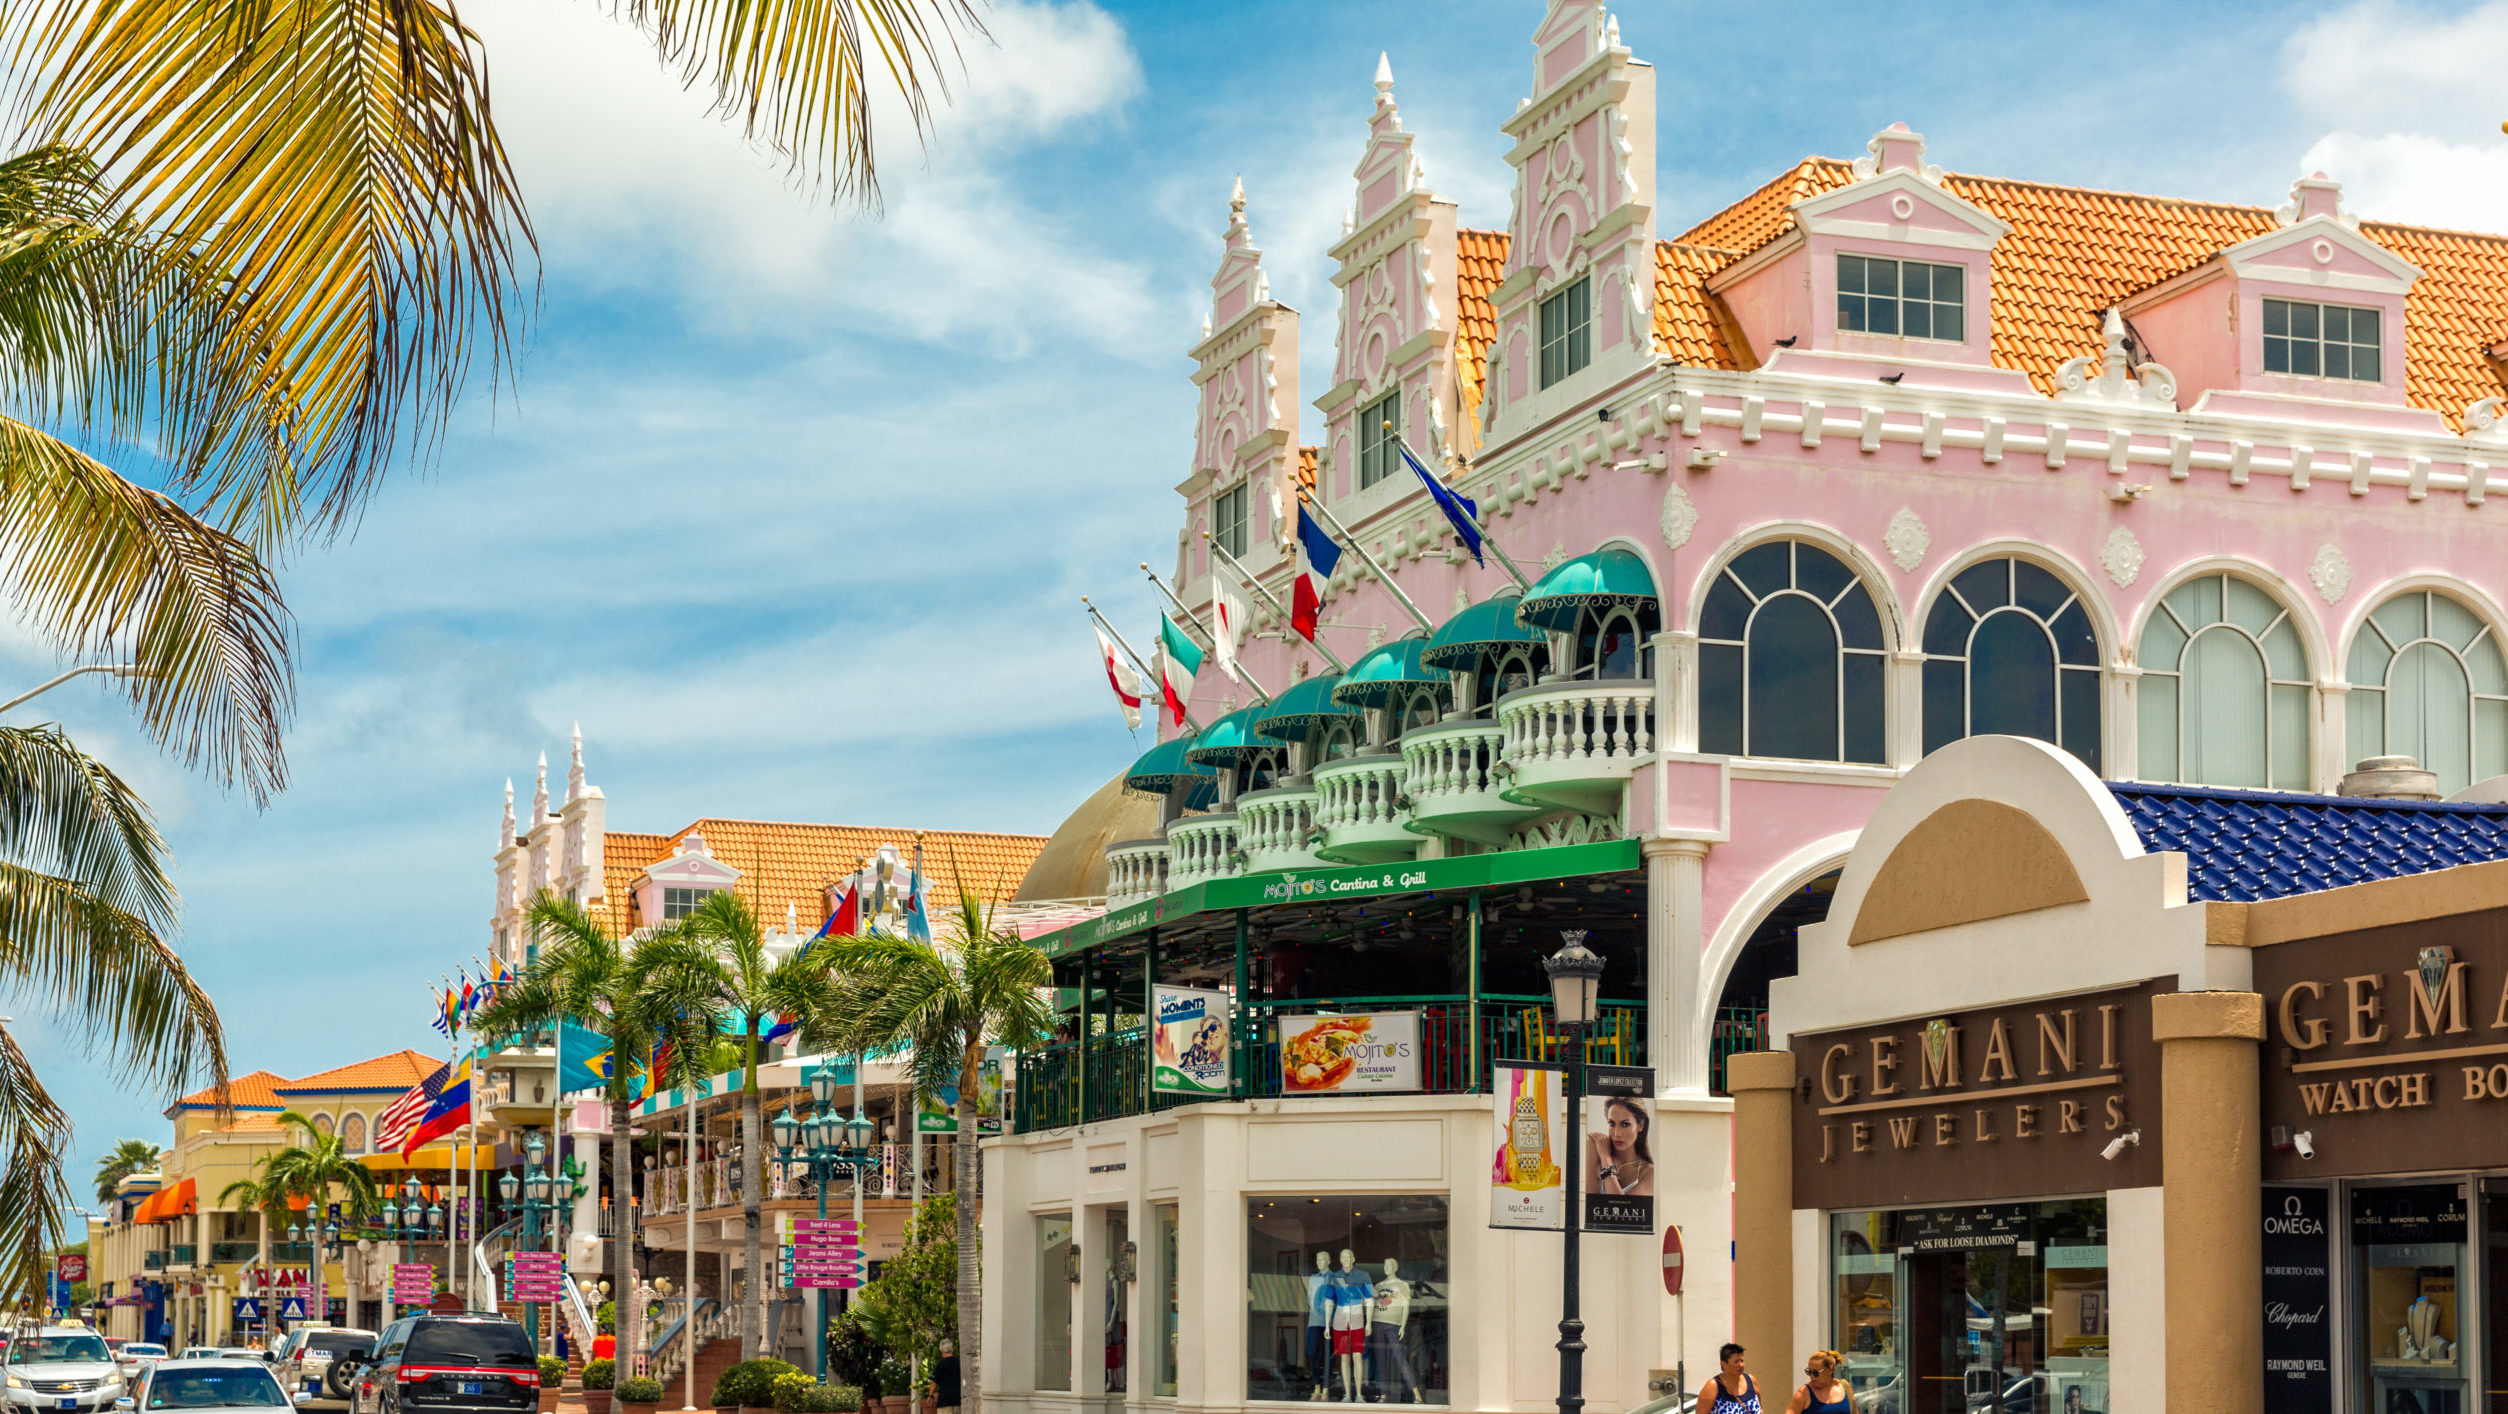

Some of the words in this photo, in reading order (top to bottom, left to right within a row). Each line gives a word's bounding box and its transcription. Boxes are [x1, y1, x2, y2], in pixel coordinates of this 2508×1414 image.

[1330, 879, 1378, 892] Cantina
[1383, 874, 1394, 887] &
[1400, 872, 1427, 888] Grill
[1116, 917, 1132, 931] Cantina
[1138, 911, 1148, 926] Grill
[1161, 997, 1205, 1015] MOMENTS
[1179, 1043, 1211, 1068] Air
[1821, 1004, 2121, 1104] GEMANI
[1183, 1061, 1224, 1072] CONDITIONED
[2298, 1072, 2431, 1116] WATCH
[1820, 1095, 2125, 1164] JEWELERS
[1507, 1204, 1545, 1213] MICHELE
[1593, 1207, 1646, 1217] GEMANI
[2437, 1213, 2466, 1222] CORUM
[2264, 1217, 2324, 1235] OMEGA
[810, 1235, 828, 1243] Hugo
[1934, 1238, 1950, 1249] FOR
[1950, 1236, 1975, 1248] LOOSE
[827, 1250, 842, 1258] Alley
[2265, 1267, 2303, 1275] ROBERTO
[2304, 1267, 2325, 1275] COIN
[2264, 1301, 2324, 1330] Chopard
[2267, 1359, 2305, 1371] RAYMOND
[2306, 1359, 2326, 1371] WEIL
